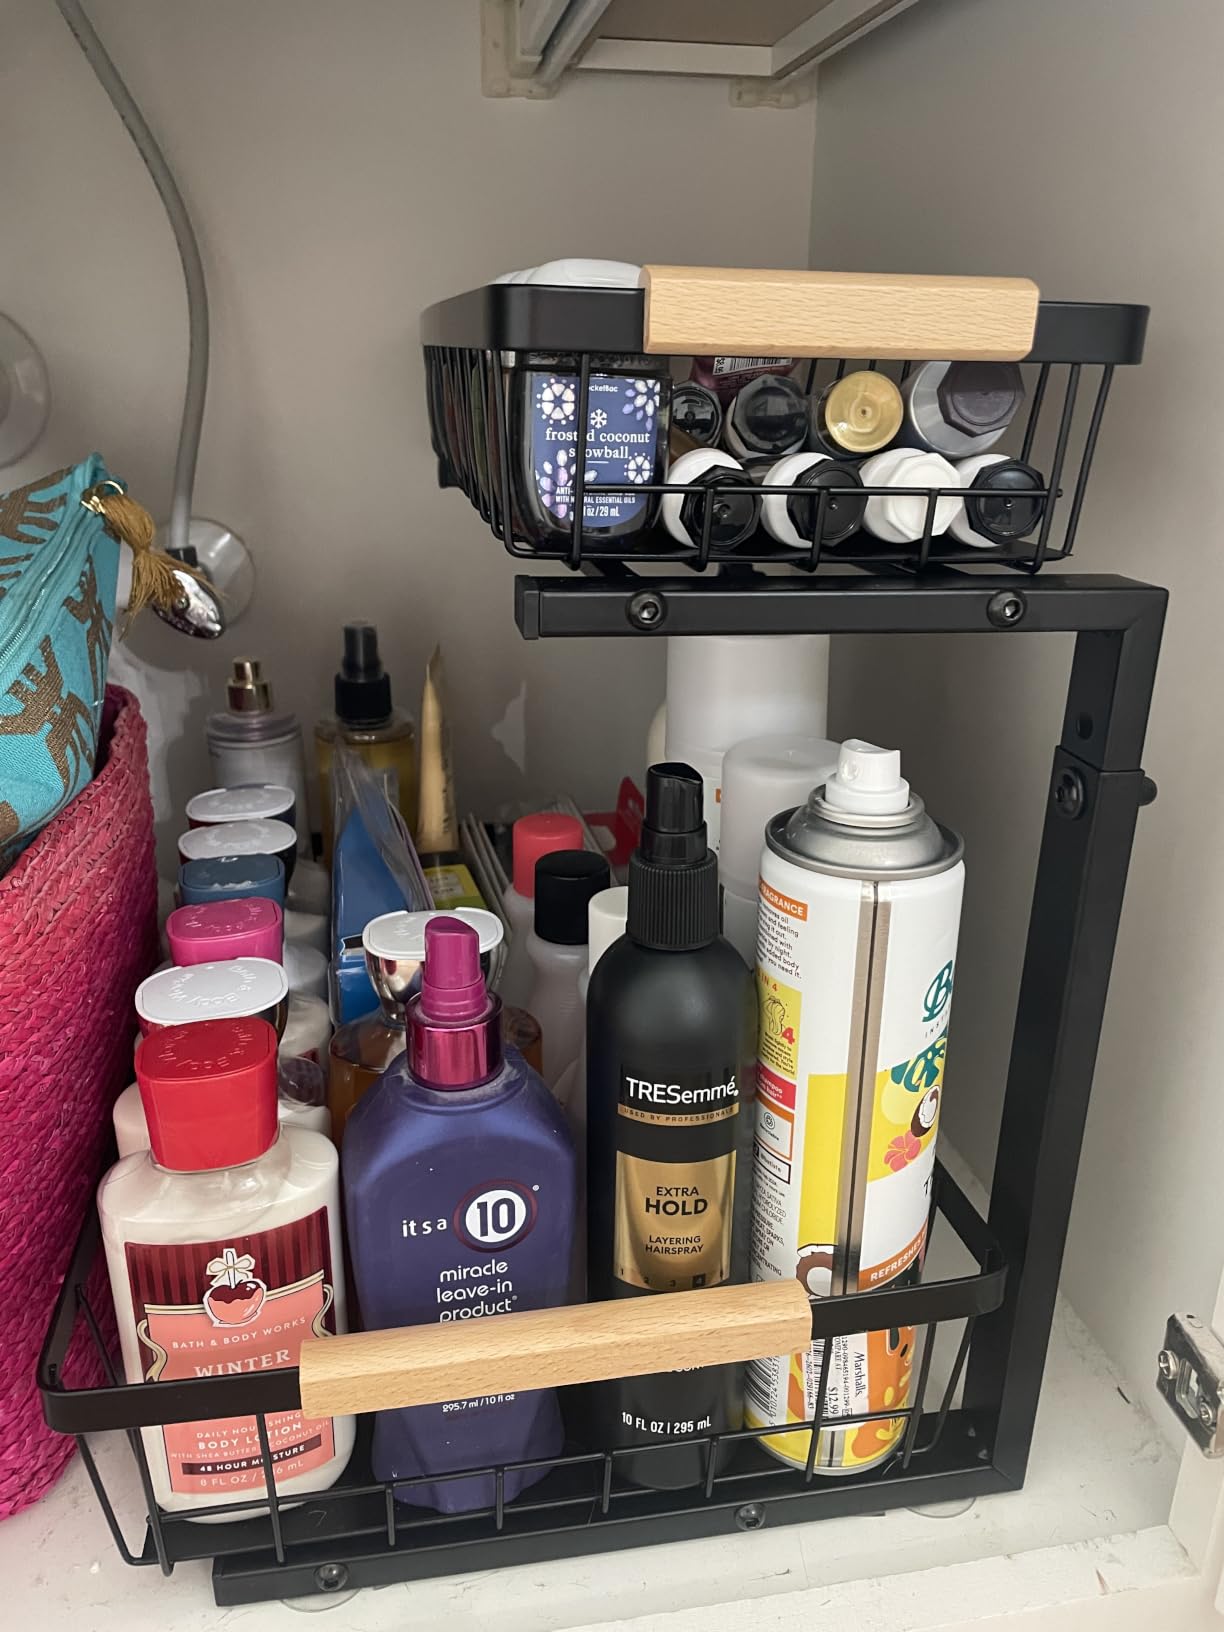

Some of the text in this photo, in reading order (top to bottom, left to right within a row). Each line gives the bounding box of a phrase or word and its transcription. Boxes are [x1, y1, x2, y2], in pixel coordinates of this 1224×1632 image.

[546, 427, 650, 443] frostd coconut
[569, 446, 628, 459] sowball
[778, 924, 799, 938] feeling
[780, 941, 793, 950] with
[783, 957, 799, 971] body
[781, 1027, 796, 1046] 4
[626, 1075, 736, 1104] TRESemmé
[665, 1107, 734, 1122] PROFESSIONALS
[656, 1186, 700, 1197] EXTRA
[645, 1197, 708, 1216] HOLD
[437, 1218, 448, 1231] a
[477, 1197, 516, 1237] 10
[645, 1244, 704, 1255] HAIRSPRAY
[649, 1235, 701, 1245] LAYERING
[440, 1259, 508, 1282] miracle
[437, 1279, 512, 1303] leave-in
[172, 1340, 204, 1349] BATH
[223, 1331, 257, 1345] BODY
[262, 1316, 306, 1336] WORKS
[193, 1348, 291, 1377] WINTER
[855, 1351, 866, 1398] Marshalls
[442, 1401, 467, 1413] 295.7
[469, 1399, 478, 1408] ml
[486, 1396, 496, 1405] 10
[828, 1386, 839, 1415] $12.99
[196, 1412, 301, 1439] DAILY NOUSHING
[622, 1412, 632, 1426] 10
[636, 1417, 647, 1431] FL
[650, 1421, 664, 1434] OZ
[674, 1420, 694, 1434] 295
[697, 1415, 711, 1431] mL
[198, 1437, 239, 1450] BODY
[223, 1446, 257, 1458] BUTTER
[200, 1444, 305, 1473] 48 HOUR MSTURE
[200, 1479, 207, 1487] 8
[212, 1477, 227, 1487] FL
[231, 1474, 248, 1485] OZ
[287, 1460, 304, 1471] mL
